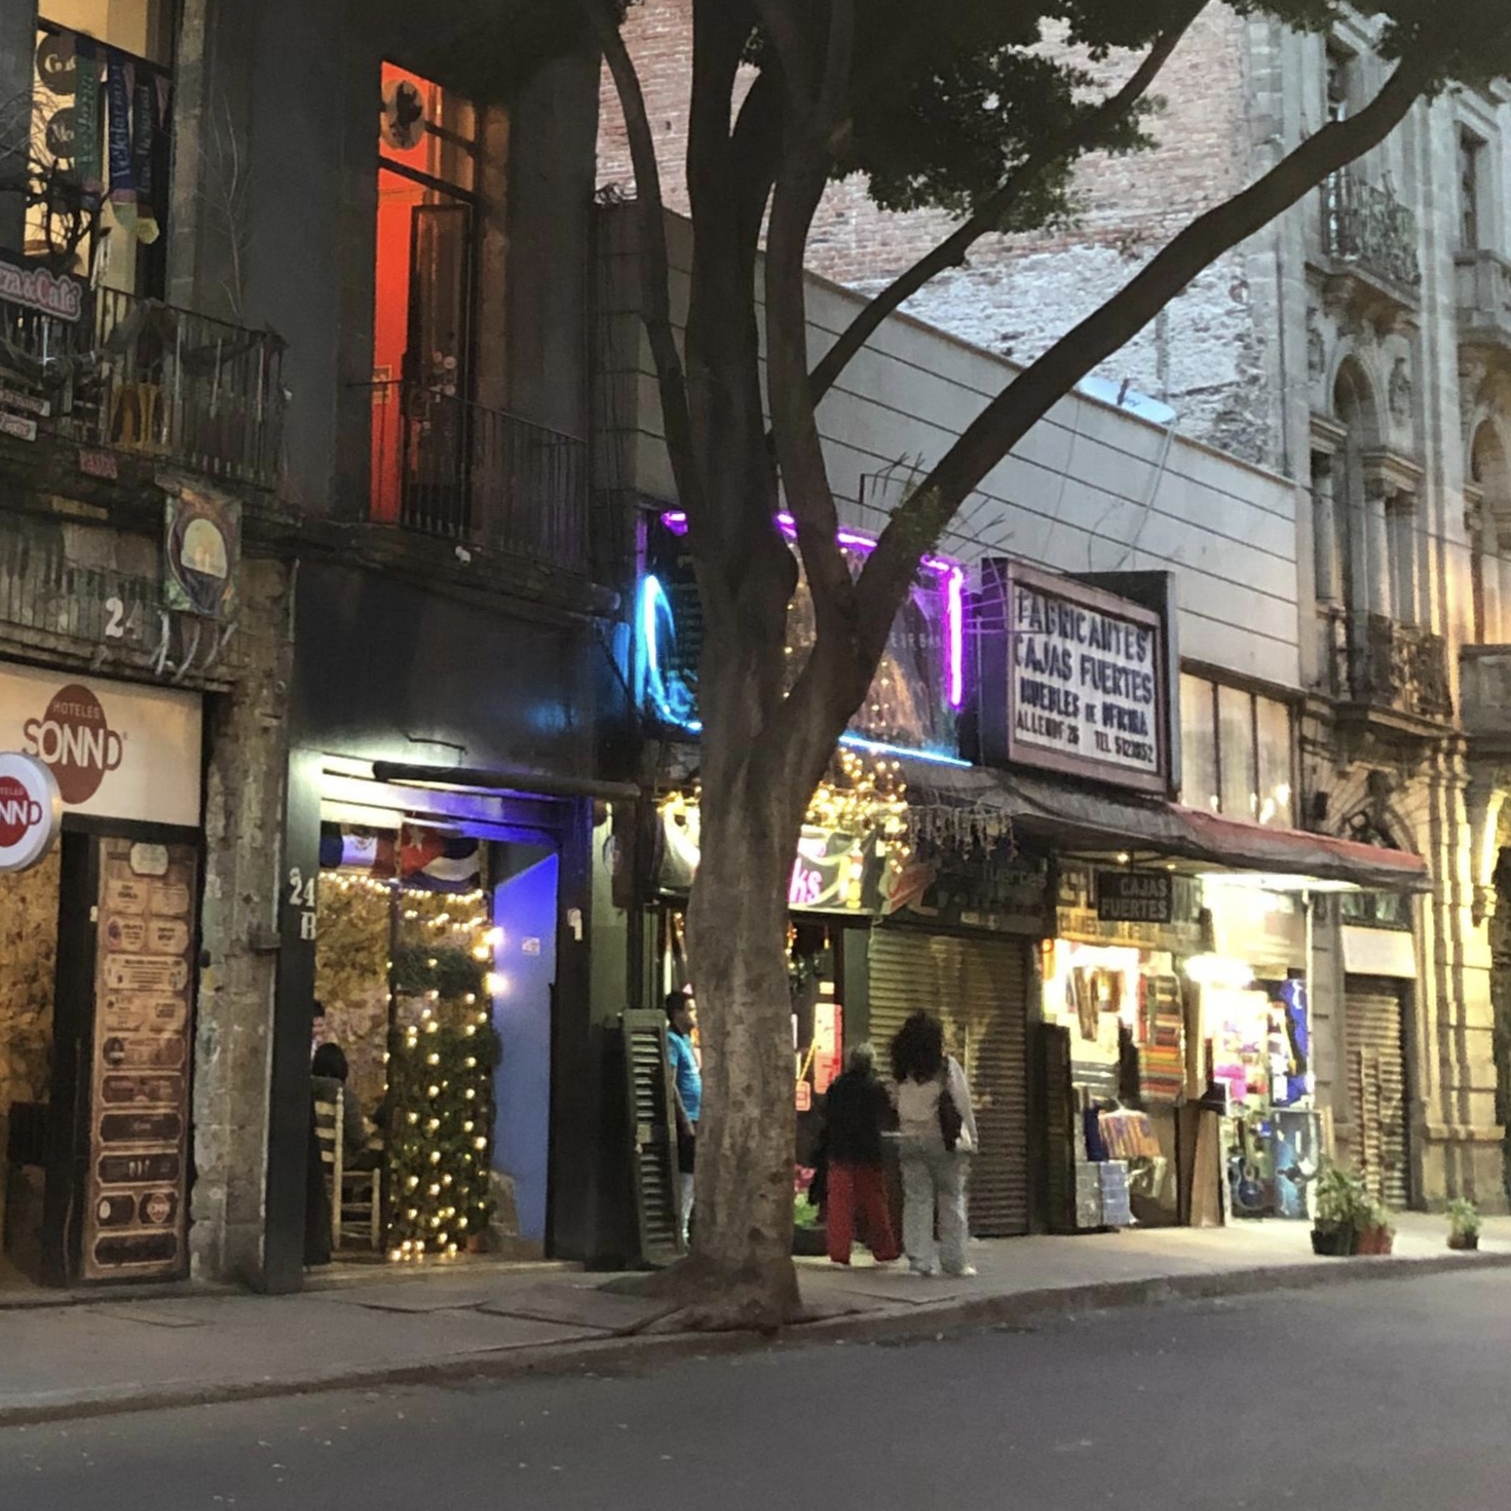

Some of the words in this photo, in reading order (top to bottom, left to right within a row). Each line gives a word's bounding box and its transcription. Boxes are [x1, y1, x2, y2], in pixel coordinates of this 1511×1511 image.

[1018, 590, 1147, 662] FABRICANTES
[1015, 635, 1073, 681] CAJAS
[1079, 654, 1152, 704] FUERTES
[52, 700, 101, 720] HOTELES
[1020, 677, 1080, 717] MUEBLES
[1120, 877, 1168, 898] CAJAS
[1101, 899, 1168, 920] FUERTES
